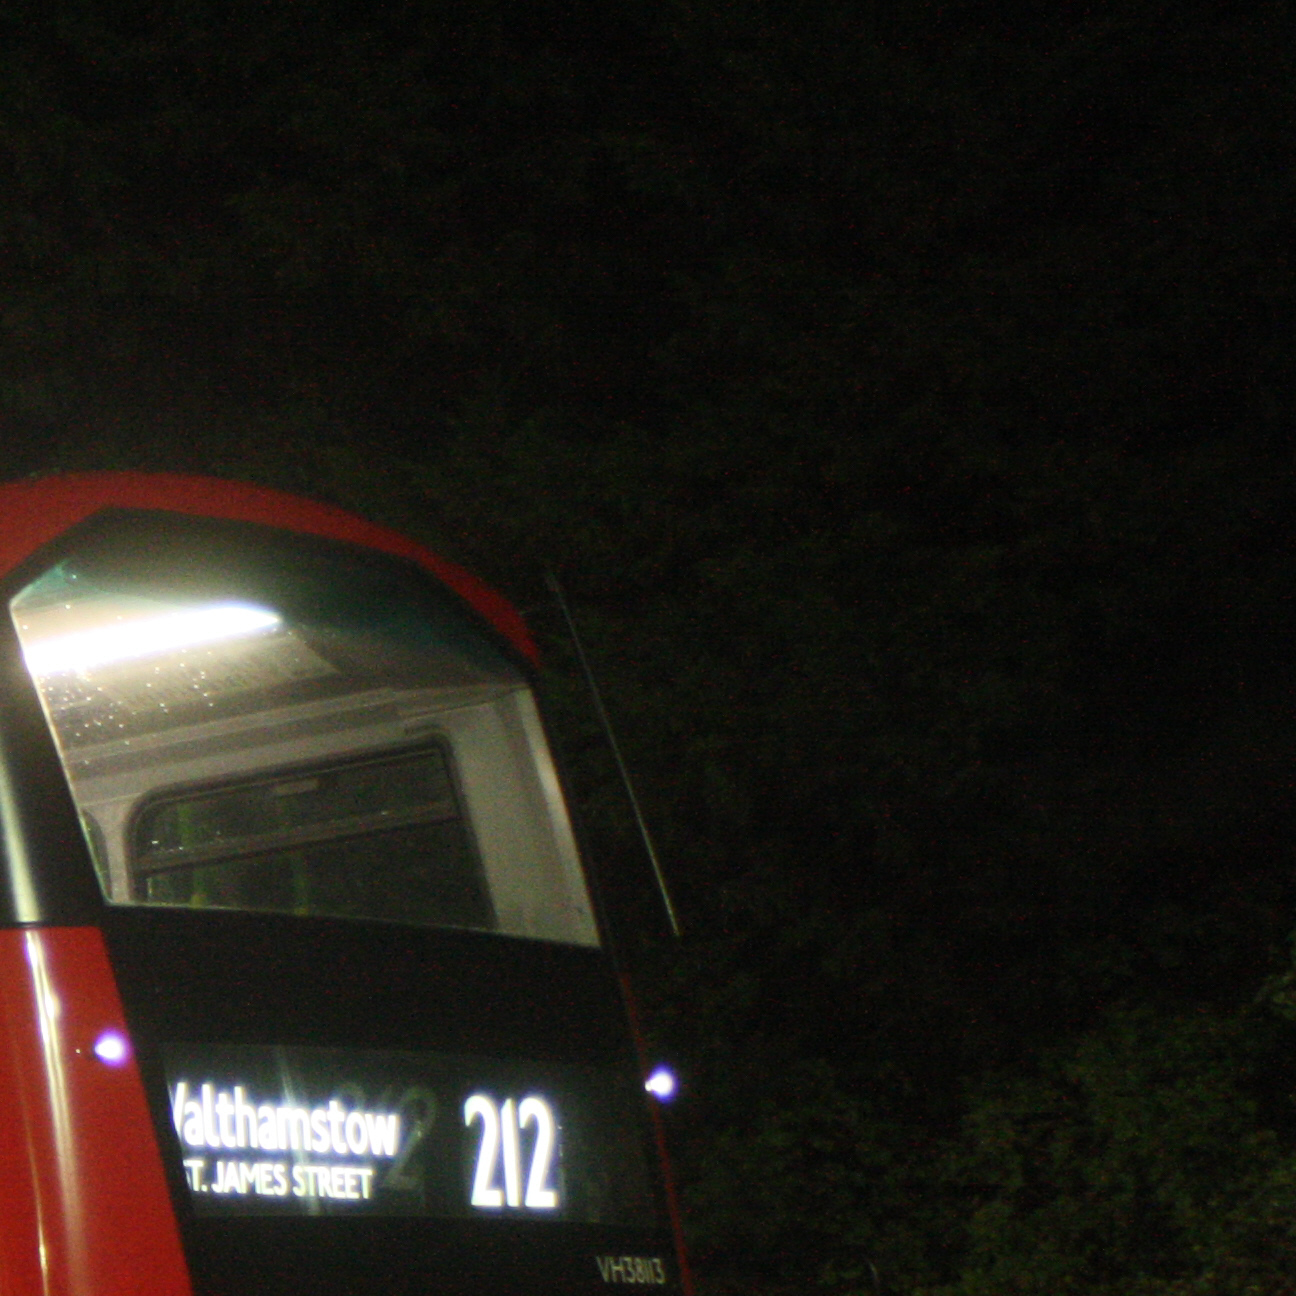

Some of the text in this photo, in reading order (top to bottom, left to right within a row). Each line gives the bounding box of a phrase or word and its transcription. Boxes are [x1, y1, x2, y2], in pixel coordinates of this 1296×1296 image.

[464, 1095, 557, 1208] 212
[211, 1161, 289, 1196] JAMES
[292, 1165, 374, 1200] STREET
[595, 1255, 666, 1285] VH38113
